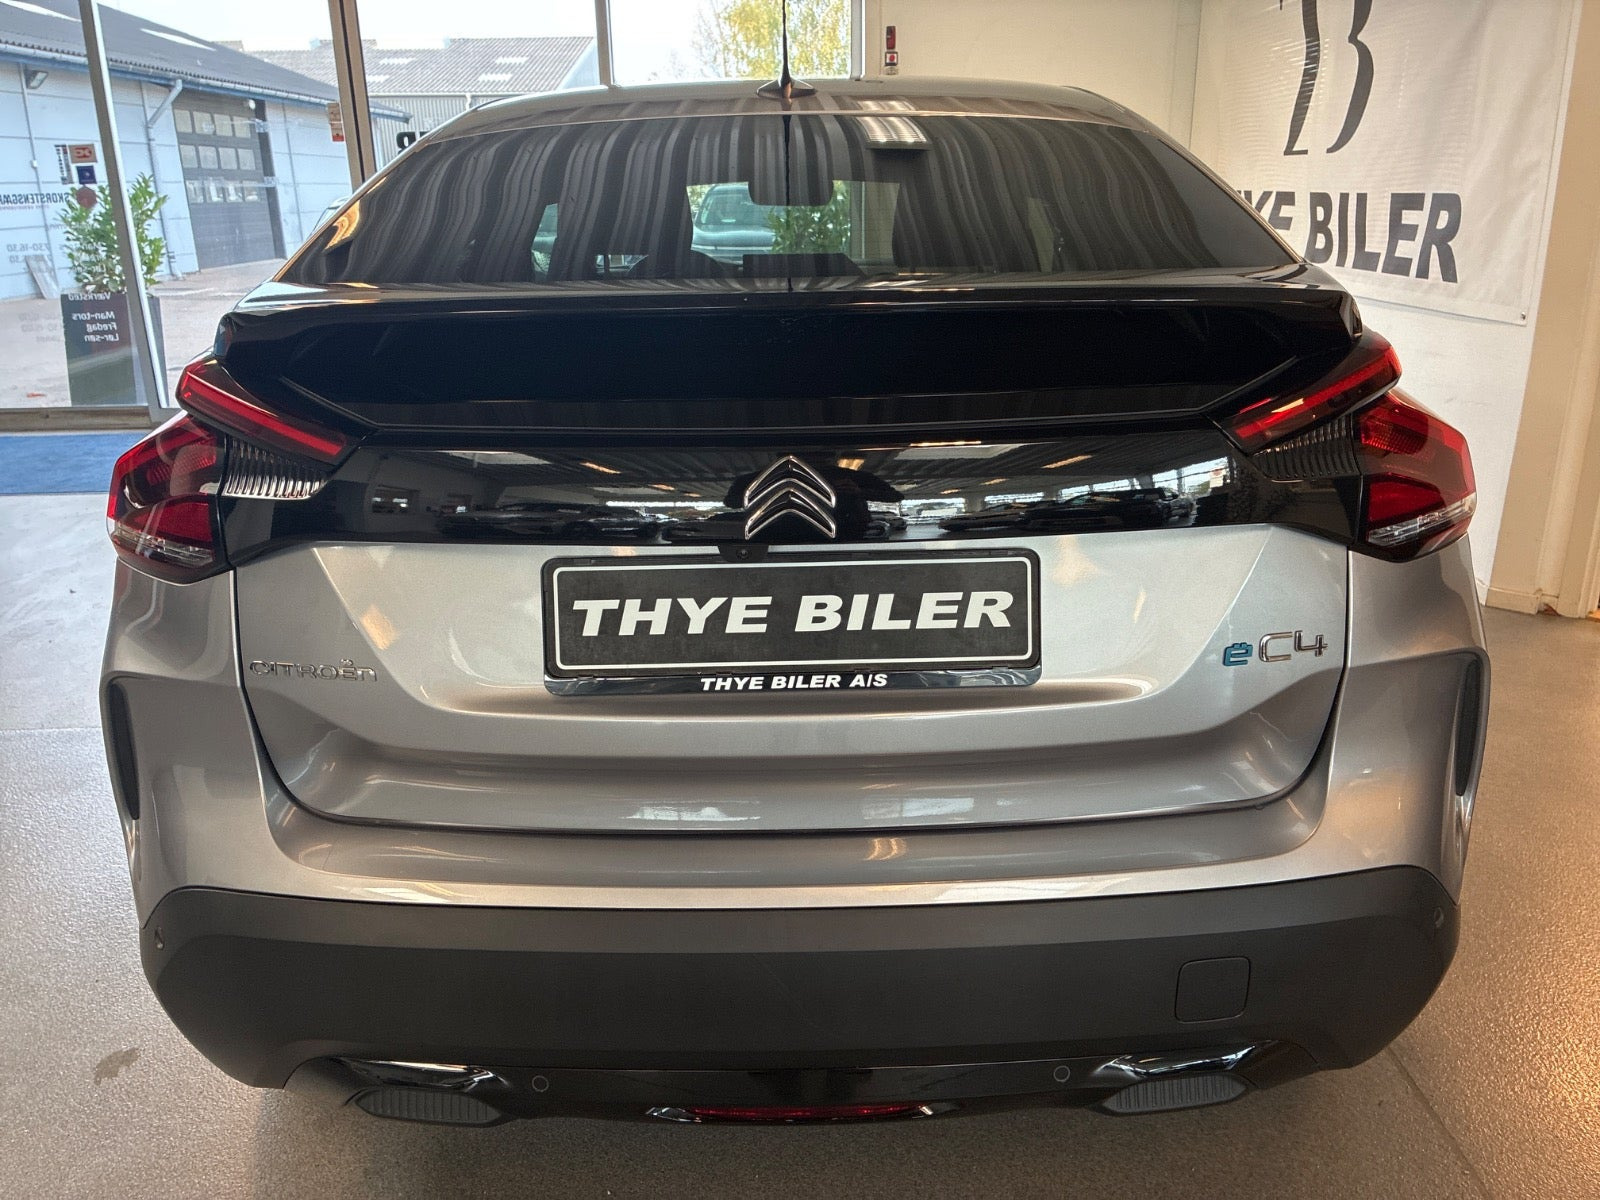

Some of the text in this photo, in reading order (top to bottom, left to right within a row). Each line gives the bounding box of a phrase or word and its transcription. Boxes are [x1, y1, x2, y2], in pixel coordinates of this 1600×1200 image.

[1304, 191, 1462, 283] BILER
[572, 591, 1014, 636] THYE BILER
[700, 673, 888, 691] THYE BILER A/S
